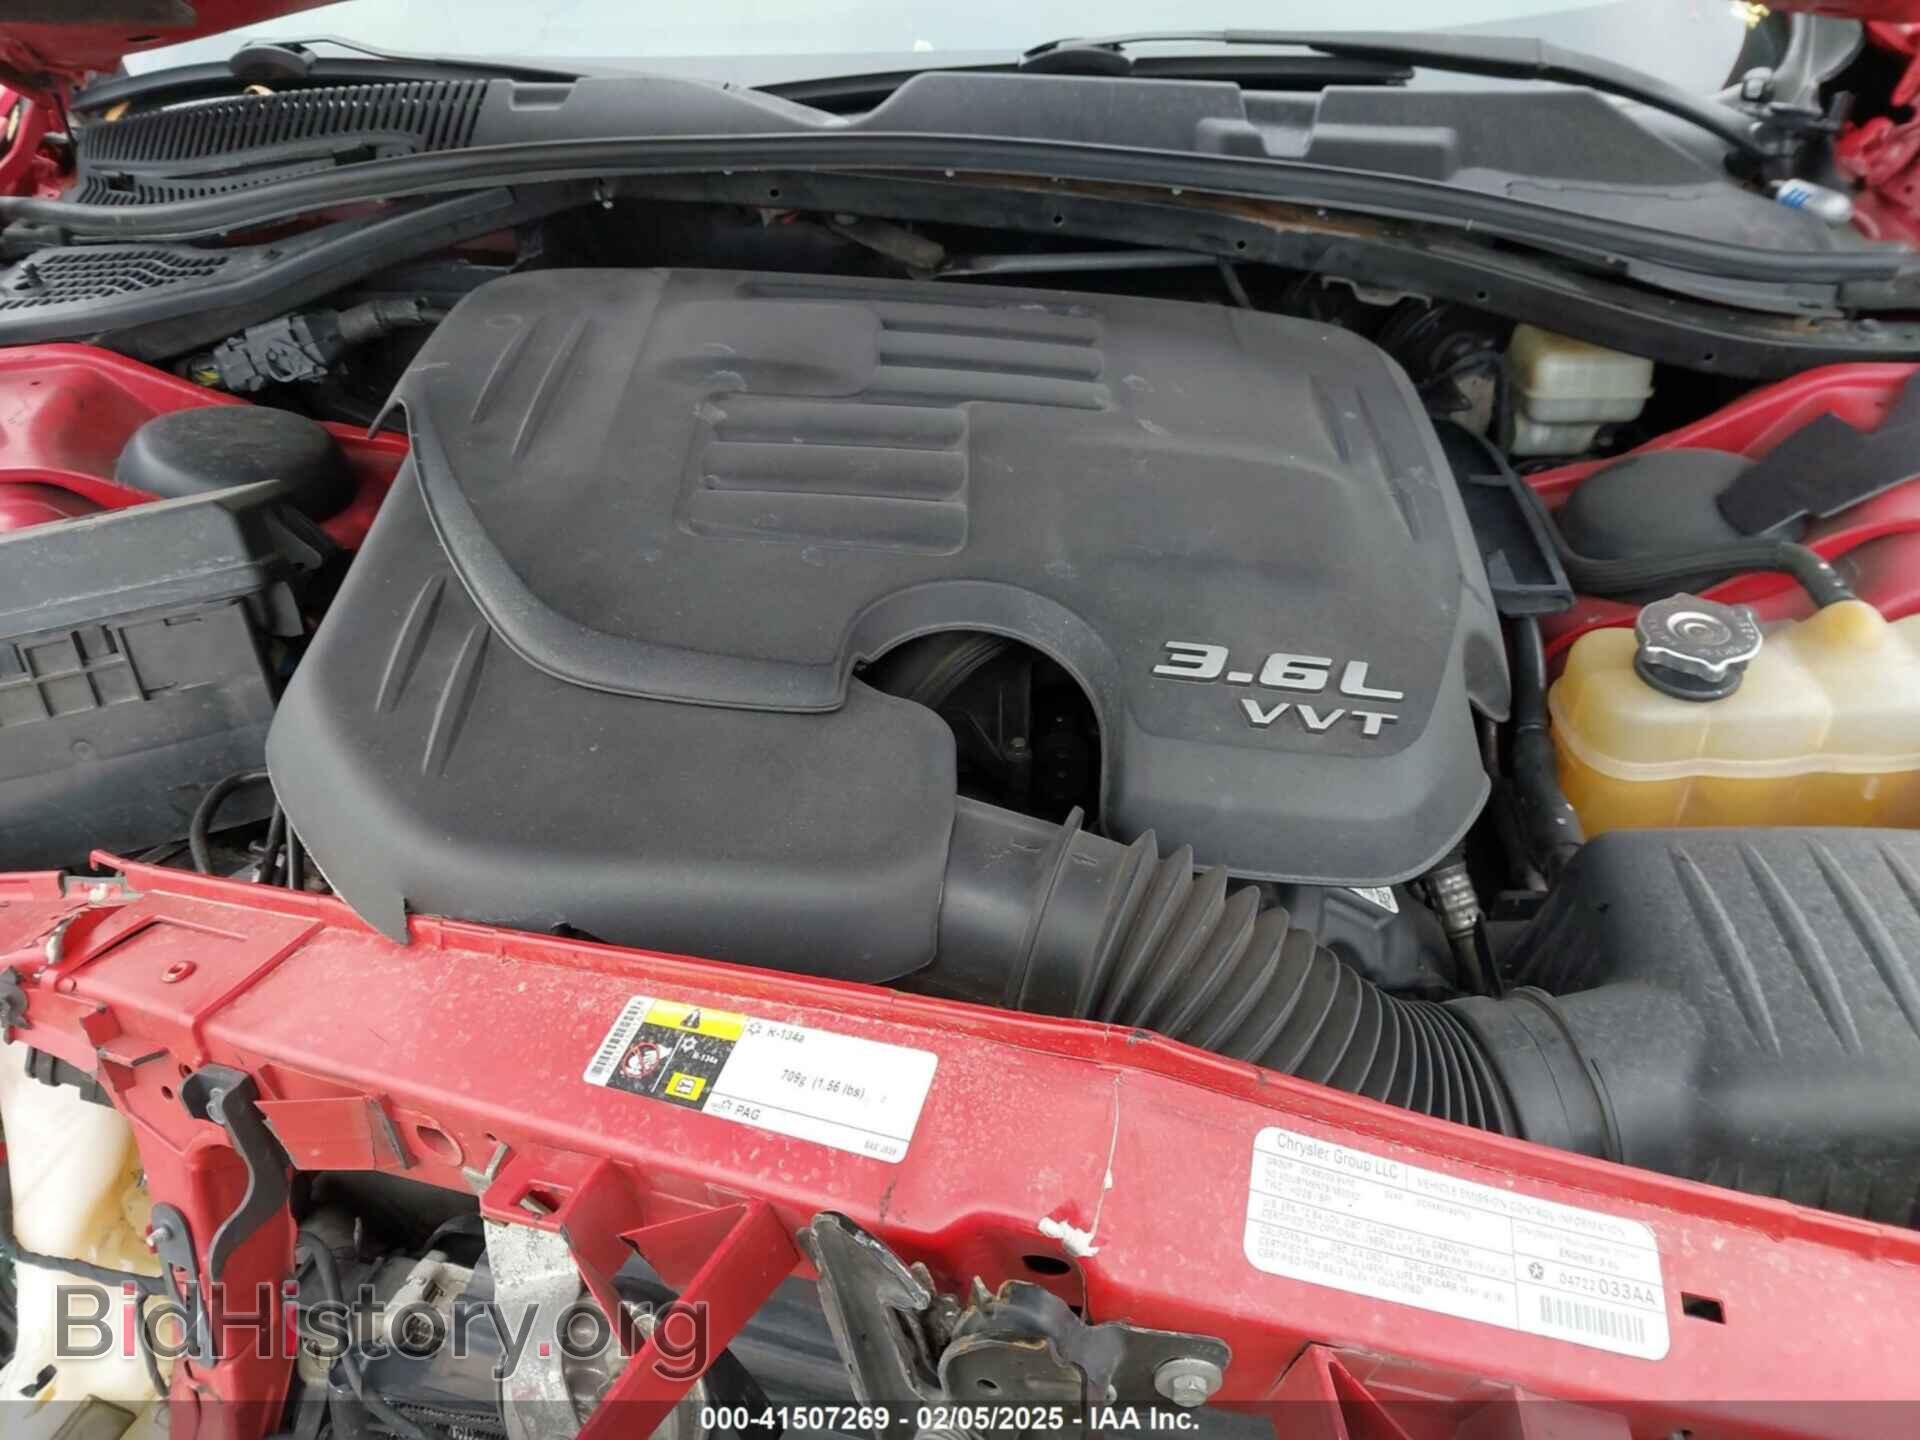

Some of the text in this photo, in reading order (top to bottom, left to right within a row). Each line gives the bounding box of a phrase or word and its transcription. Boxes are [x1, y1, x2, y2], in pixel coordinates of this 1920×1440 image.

[1152, 641, 1404, 700] 3.6L
[1240, 698, 1398, 736] VVT
[734, 1103, 762, 1121] PAG
[1277, 1132, 1330, 1162] Chrysler
[1333, 1148, 1372, 1173] Group
[1374, 1159, 1400, 1180] LLC
